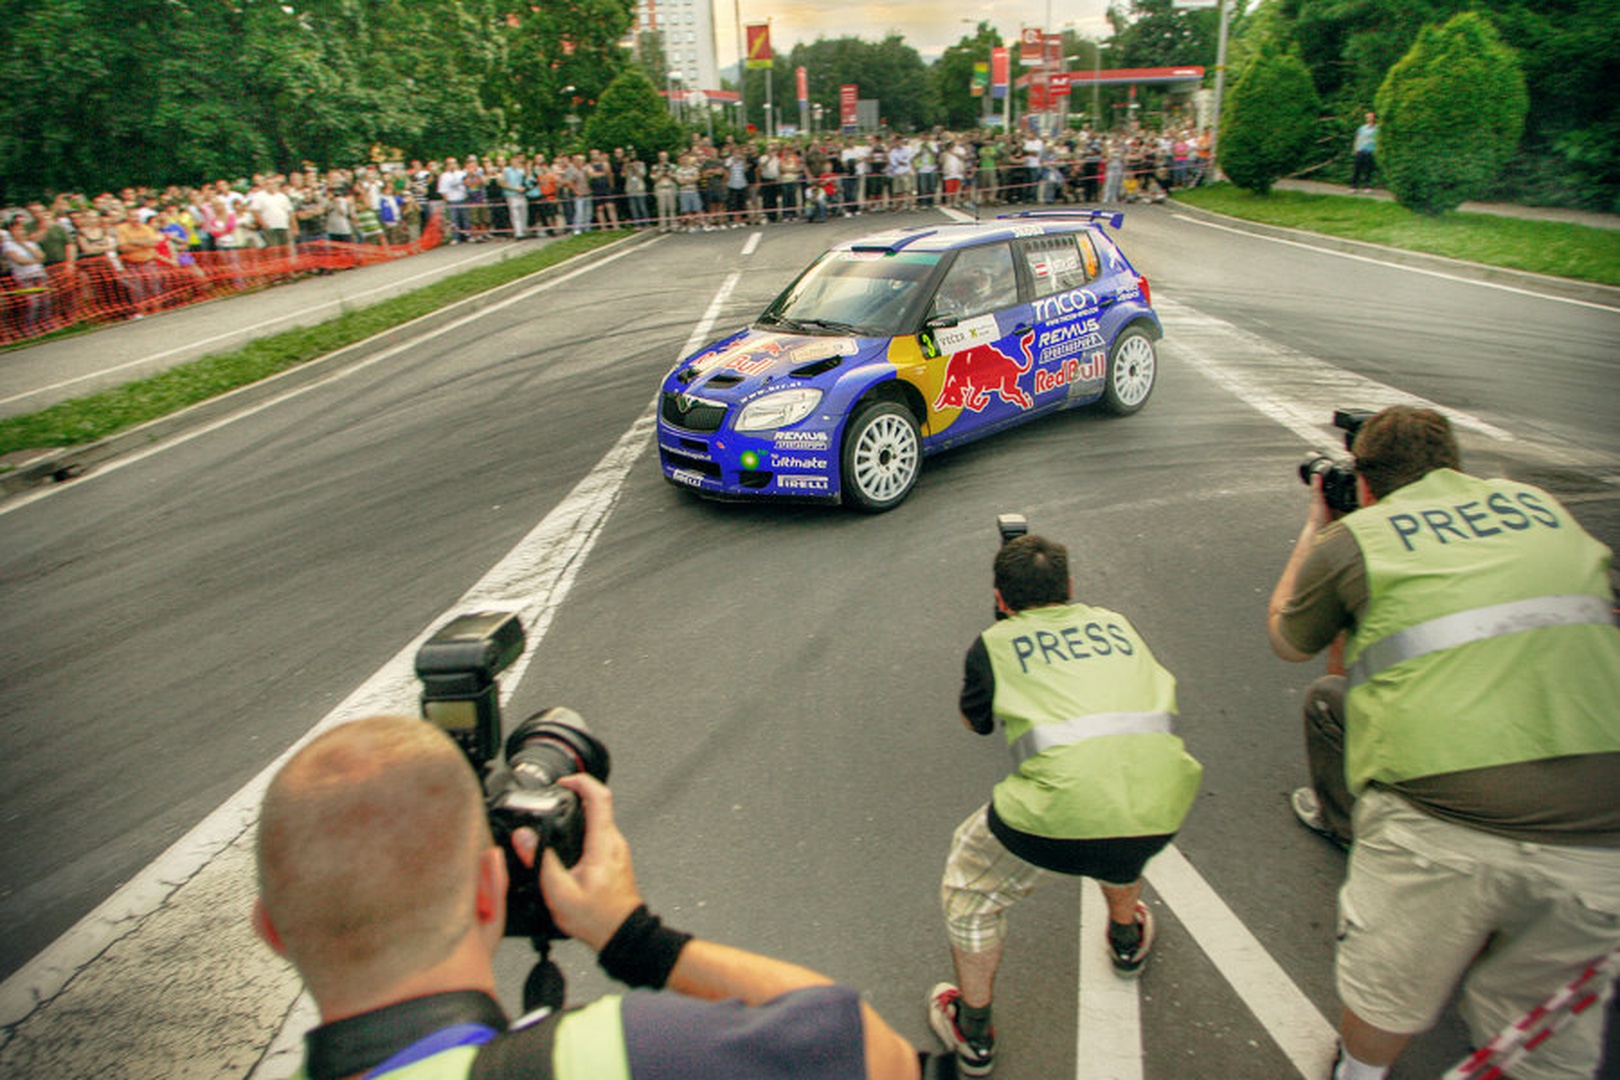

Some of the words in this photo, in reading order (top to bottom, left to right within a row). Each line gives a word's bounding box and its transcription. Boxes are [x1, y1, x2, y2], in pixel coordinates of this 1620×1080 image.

[1038, 318, 1100, 348] REMUS
[1034, 359, 1066, 394] Red
[1067, 352, 1107, 383] Bull
[773, 432, 828, 441] REMUS
[771, 456, 827, 468] ultimate
[777, 474, 829, 489] PIRELLI
[1388, 491, 1560, 551] PRESS
[1012, 622, 1133, 673] PRESS
